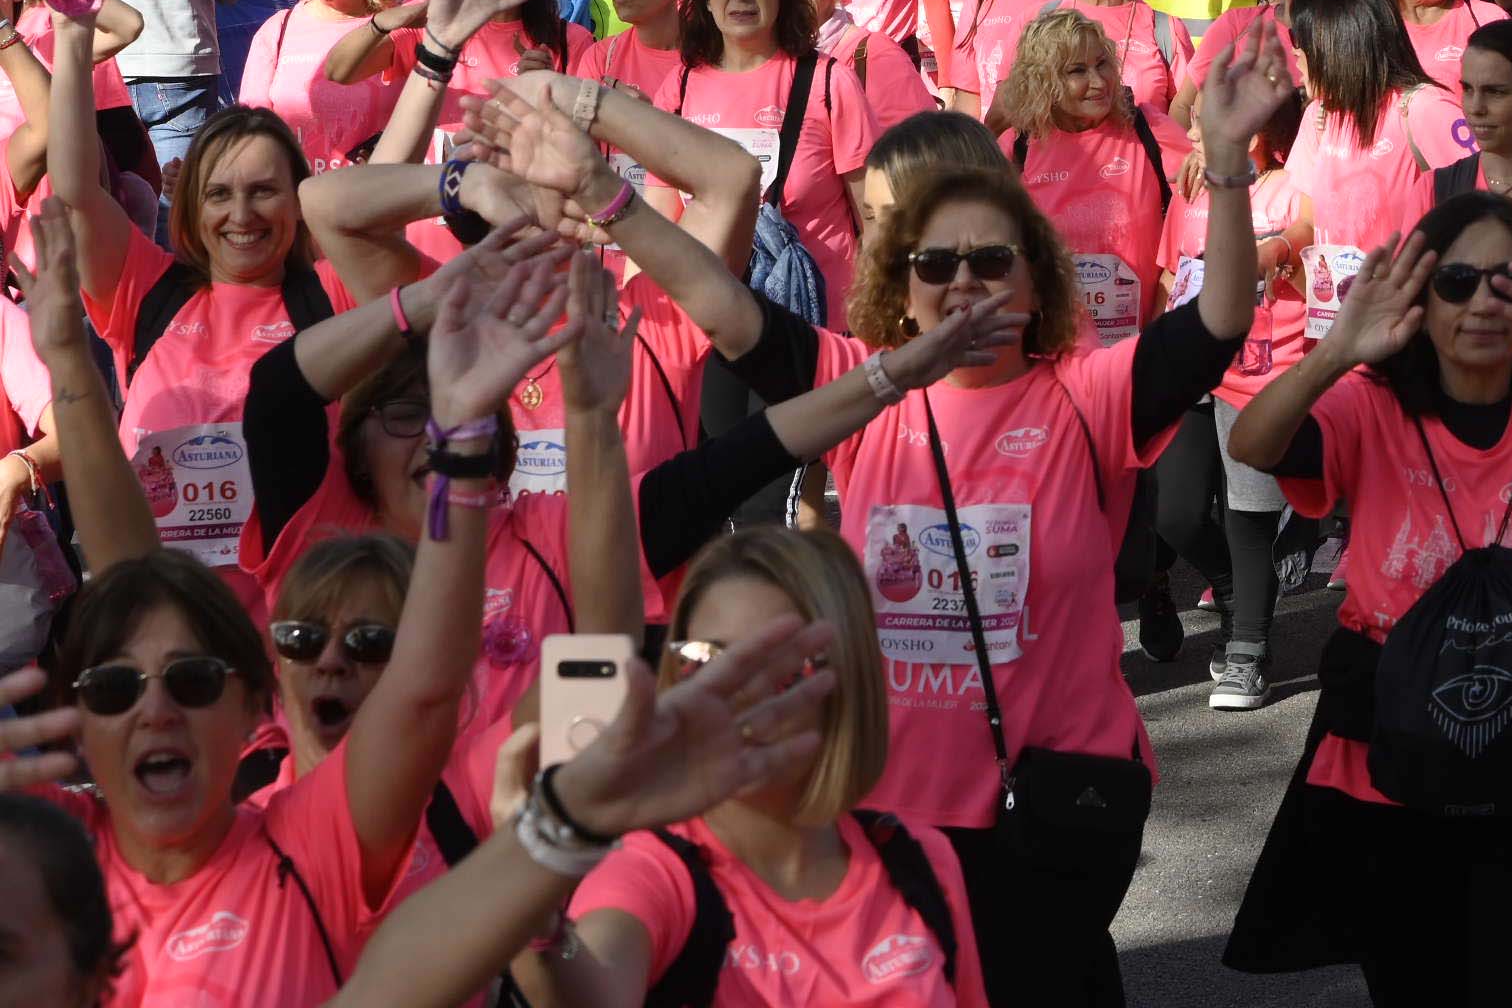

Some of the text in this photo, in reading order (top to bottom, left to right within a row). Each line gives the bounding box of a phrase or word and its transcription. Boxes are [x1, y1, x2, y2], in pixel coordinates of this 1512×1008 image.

[1084, 291, 1105, 305] 16
[177, 449, 238, 463] ASTURIANA
[183, 480, 238, 502] 016
[189, 507, 231, 522] 22560
[160, 527, 191, 537] RRERA
[193, 528, 205, 536] DE
[208, 527, 221, 535] LA
[931, 597, 967, 611] 2237
[885, 617, 933, 628] CARRERA
[936, 618, 950, 628] DE
[951, 619, 964, 628] LA
[880, 638, 934, 652] OYSHO
[888, 659, 985, 696] UMA
